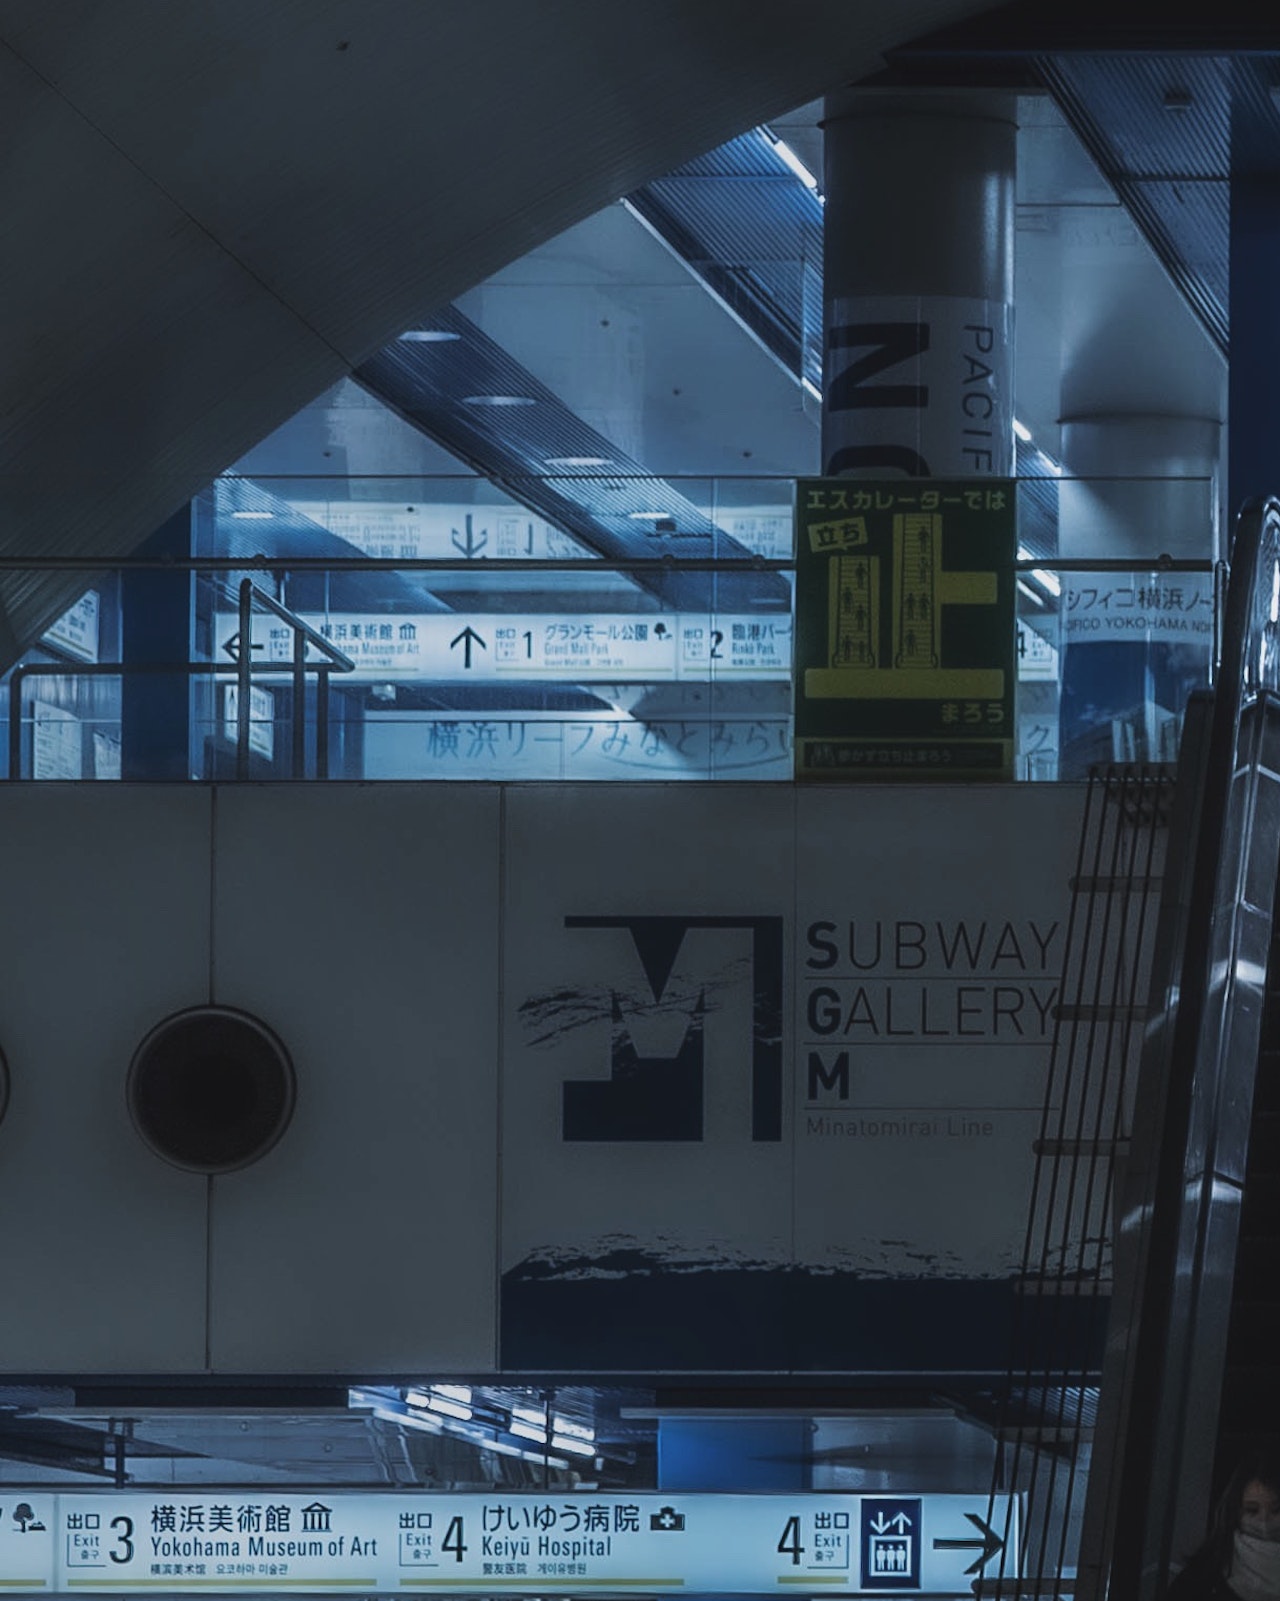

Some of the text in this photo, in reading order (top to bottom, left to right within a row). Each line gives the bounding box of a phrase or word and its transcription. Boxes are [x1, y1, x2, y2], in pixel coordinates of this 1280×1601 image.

[807, 490, 1007, 511] エスカレーターでは
[816, 522, 861, 548] 立ち
[496, 629, 516, 639] 出口
[545, 622, 648, 641] グランモール公園
[683, 629, 703, 639] 出口
[732, 623, 793, 641] 臨港パー
[522, 631, 532, 659] 1
[710, 630, 724, 659] 2
[942, 703, 1004, 723] まろう
[806, 920, 1060, 970] SUBWAY
[806, 986, 1058, 1036] GALLERY
[807, 1051, 850, 1101] M
[806, 1117, 993, 1137] Minatomirai Line
[67, 1513, 100, 1530] 出口
[151, 1505, 291, 1533] 横浜美術館
[400, 1512, 432, 1530] 出口
[482, 1504, 641, 1533] けいゆう病院
[815, 1512, 849, 1529] 出口
[74, 1534, 100, 1548] Exit
[109, 1516, 135, 1564] 3
[151, 1536, 378, 1557] Yokohama Museum of Art
[406, 1534, 432, 1547] Exit
[441, 1516, 468, 1563] 4
[482, 1535, 611, 1560] Keiyū Hospital
[777, 1516, 805, 1565] 4
[815, 1534, 842, 1548] Exit
